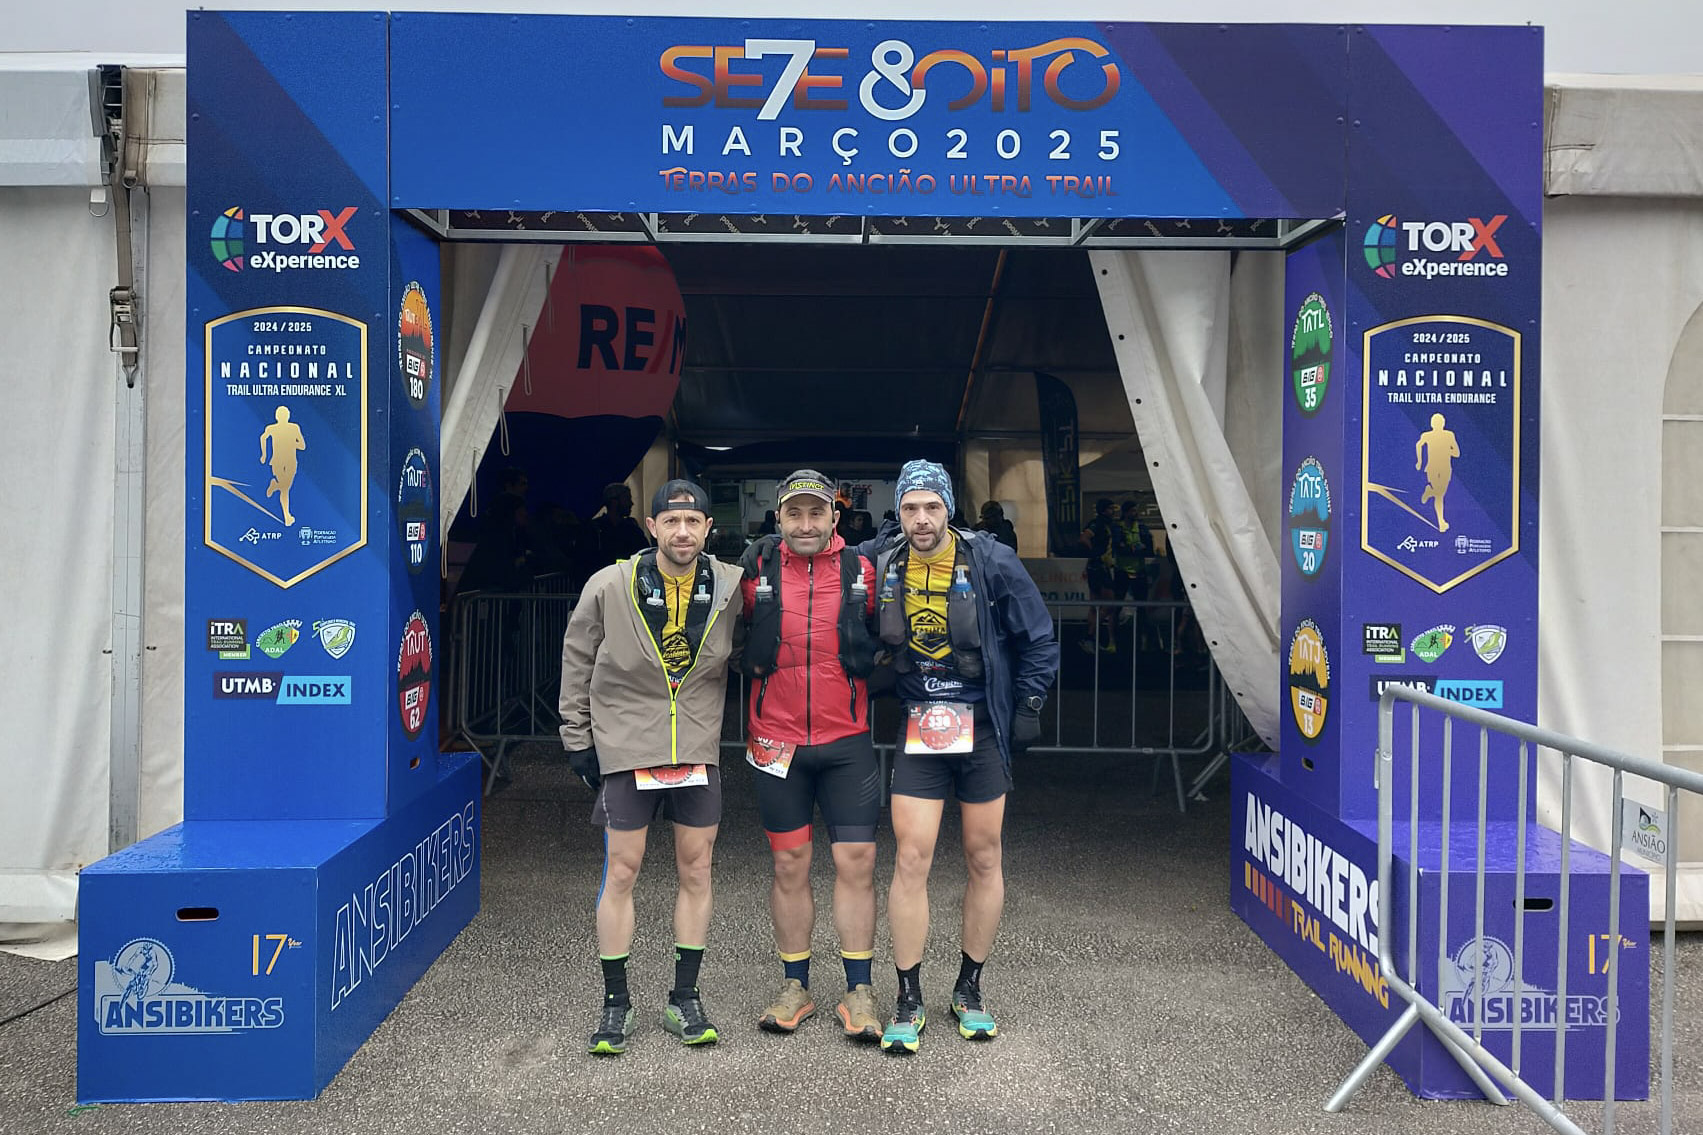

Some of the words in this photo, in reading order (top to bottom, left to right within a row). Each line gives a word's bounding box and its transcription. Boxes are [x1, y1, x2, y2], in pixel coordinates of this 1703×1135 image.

[659, 167, 757, 194] TERRAS
[772, 172, 813, 193] DO
[827, 168, 937, 195] ANCIÃO
[950, 174, 1032, 199] ULTRA
[1046, 175, 1119, 199] TRAIL
[250, 206, 359, 253] TORX
[1402, 215, 1509, 261] TORX
[250, 251, 360, 272] eXperience
[1402, 258, 1508, 279] eXperience
[1301, 309, 1324, 334] TATL
[248, 344, 327, 355] CAMPEONATO
[1404, 353, 1481, 364] CAMPEONATO
[221, 362, 353, 379] NACIONAL
[1379, 369, 1507, 387] NACIONAL
[227, 384, 250, 395] TRAIL
[252, 384, 279, 395] ULTRA
[281, 384, 331, 396] ENDURANCE
[335, 384, 347, 396] XL
[409, 377, 424, 400] 180
[1304, 386, 1317, 408] 35
[1387, 392, 1412, 403] TRAIL
[1415, 392, 1442, 403] ULTRA
[1445, 393, 1497, 404] ENDURANCE
[1299, 472, 1321, 498] TATS
[262, 532, 282, 540] ATRP
[1419, 540, 1439, 548] ATRP
[410, 543, 423, 563] 110
[1303, 551, 1315, 572] 20
[406, 629, 425, 657] TAUT
[221, 678, 273, 693] UTMB
[286, 683, 345, 698] INDEX
[1441, 687, 1497, 701] INDEX
[409, 707, 420, 729] 62
[1303, 714, 1314, 735] 13
[1632, 830, 1666, 854] ANSIÃO
[331, 801, 475, 1010] ANSIBIKERS
[253, 934, 288, 975] 17
[1291, 900, 1325, 952] TRAIL
[1329, 932, 1389, 1009] RUNNING
[104, 1000, 284, 1029] ANSIBIKERS
